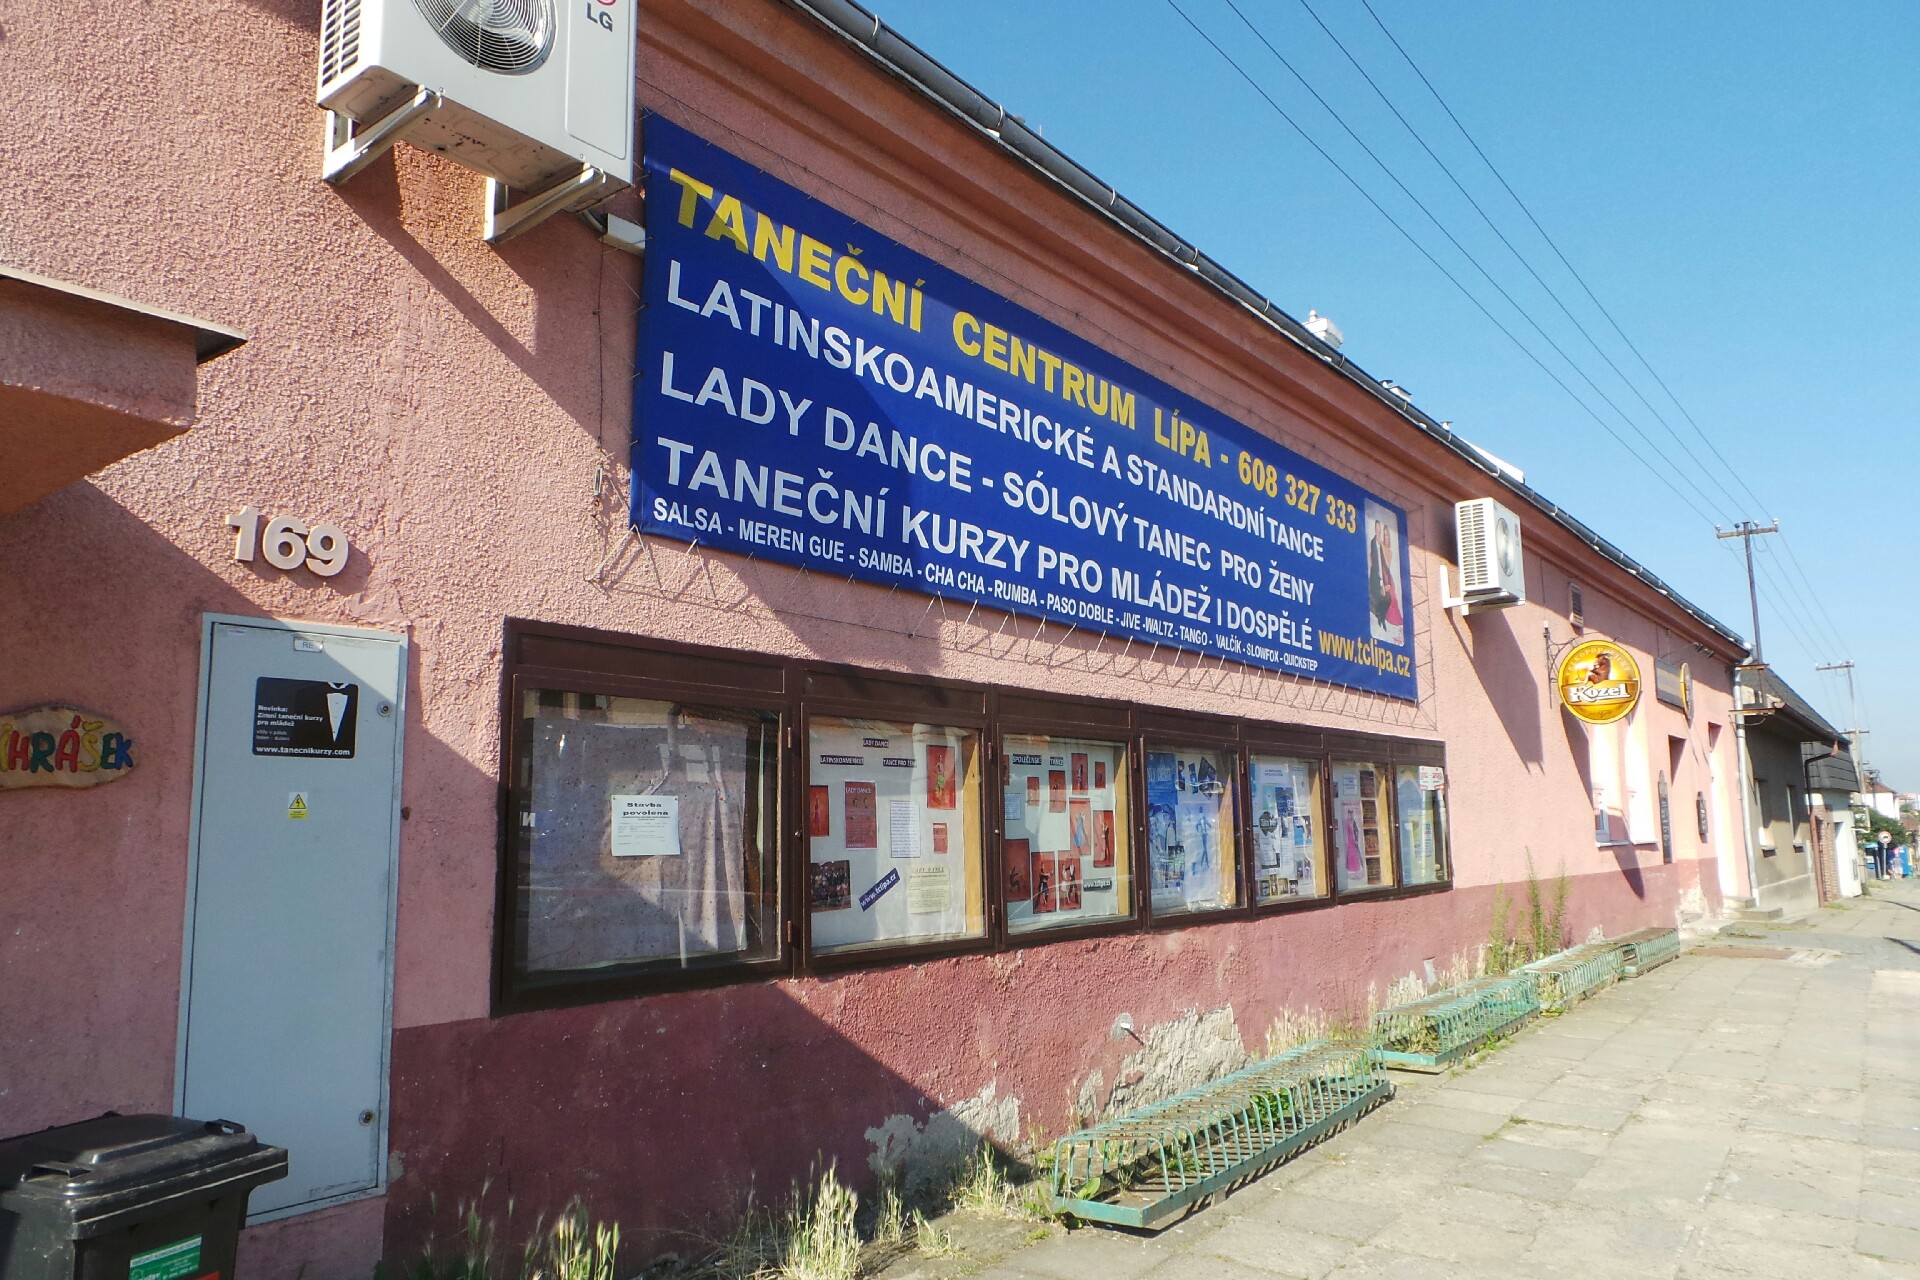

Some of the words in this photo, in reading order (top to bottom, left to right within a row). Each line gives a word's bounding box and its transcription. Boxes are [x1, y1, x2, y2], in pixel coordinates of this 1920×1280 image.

[586, 2, 613, 32] LG
[667, 259, 1095, 469] LATINSKOAMERICKÉ
[1101, 445, 1122, 480] A
[1127, 454, 1265, 539] STANDARDNÍ
[1266, 516, 1325, 562] TANCE
[670, 167, 925, 333] TANEČNÍ
[952, 311, 1136, 430] CENTRUM
[1154, 408, 1212, 468] LÍPA
[1238, 451, 1278, 498] 608
[1284, 474, 1320, 516] 327
[1326, 494, 1357, 534] 333
[660, 350, 813, 437] LADY
[824, 406, 972, 493] DANCE
[1002, 470, 1129, 542] SÓLOVÝ
[1133, 516, 1212, 571] TANEC
[1220, 550, 1262, 589] PRO
[1268, 559, 1315, 606] ŽENY
[225, 505, 348, 577] 169
[653, 497, 723, 535] SALSA
[738, 518, 804, 554] MEREN
[808, 535, 844, 563] GUE
[858, 547, 914, 578] SAMBA
[925, 562, 955, 587] CHA
[957, 571, 985, 594] CHA
[994, 579, 1038, 607] RUMBA
[1046, 593, 1077, 616] PASO
[1079, 600, 1114, 625] DOBLE
[1120, 611, 1141, 631] JIVE
[1179, 625, 1208, 646] TANGO
[1216, 634, 1242, 655] VALČÍK
[1246, 642, 1279, 663] SLOWFOX
[1283, 652, 1318, 672] QUICKSTEP
[657, 436, 890, 538] TANEČNÍ
[902, 505, 1031, 573] KURZY
[1037, 545, 1103, 594] PRO
[1111, 567, 1212, 624] MLÁDEŽ
[1216, 598, 1222, 627] I
[1226, 600, 1313, 651] DOSPĚLÉ
[1318, 630, 1411, 678] www.tclipa.cz
[1568, 683, 1631, 703] Kozel
[256, 746, 350, 756] www.tanecnikurzy.com
